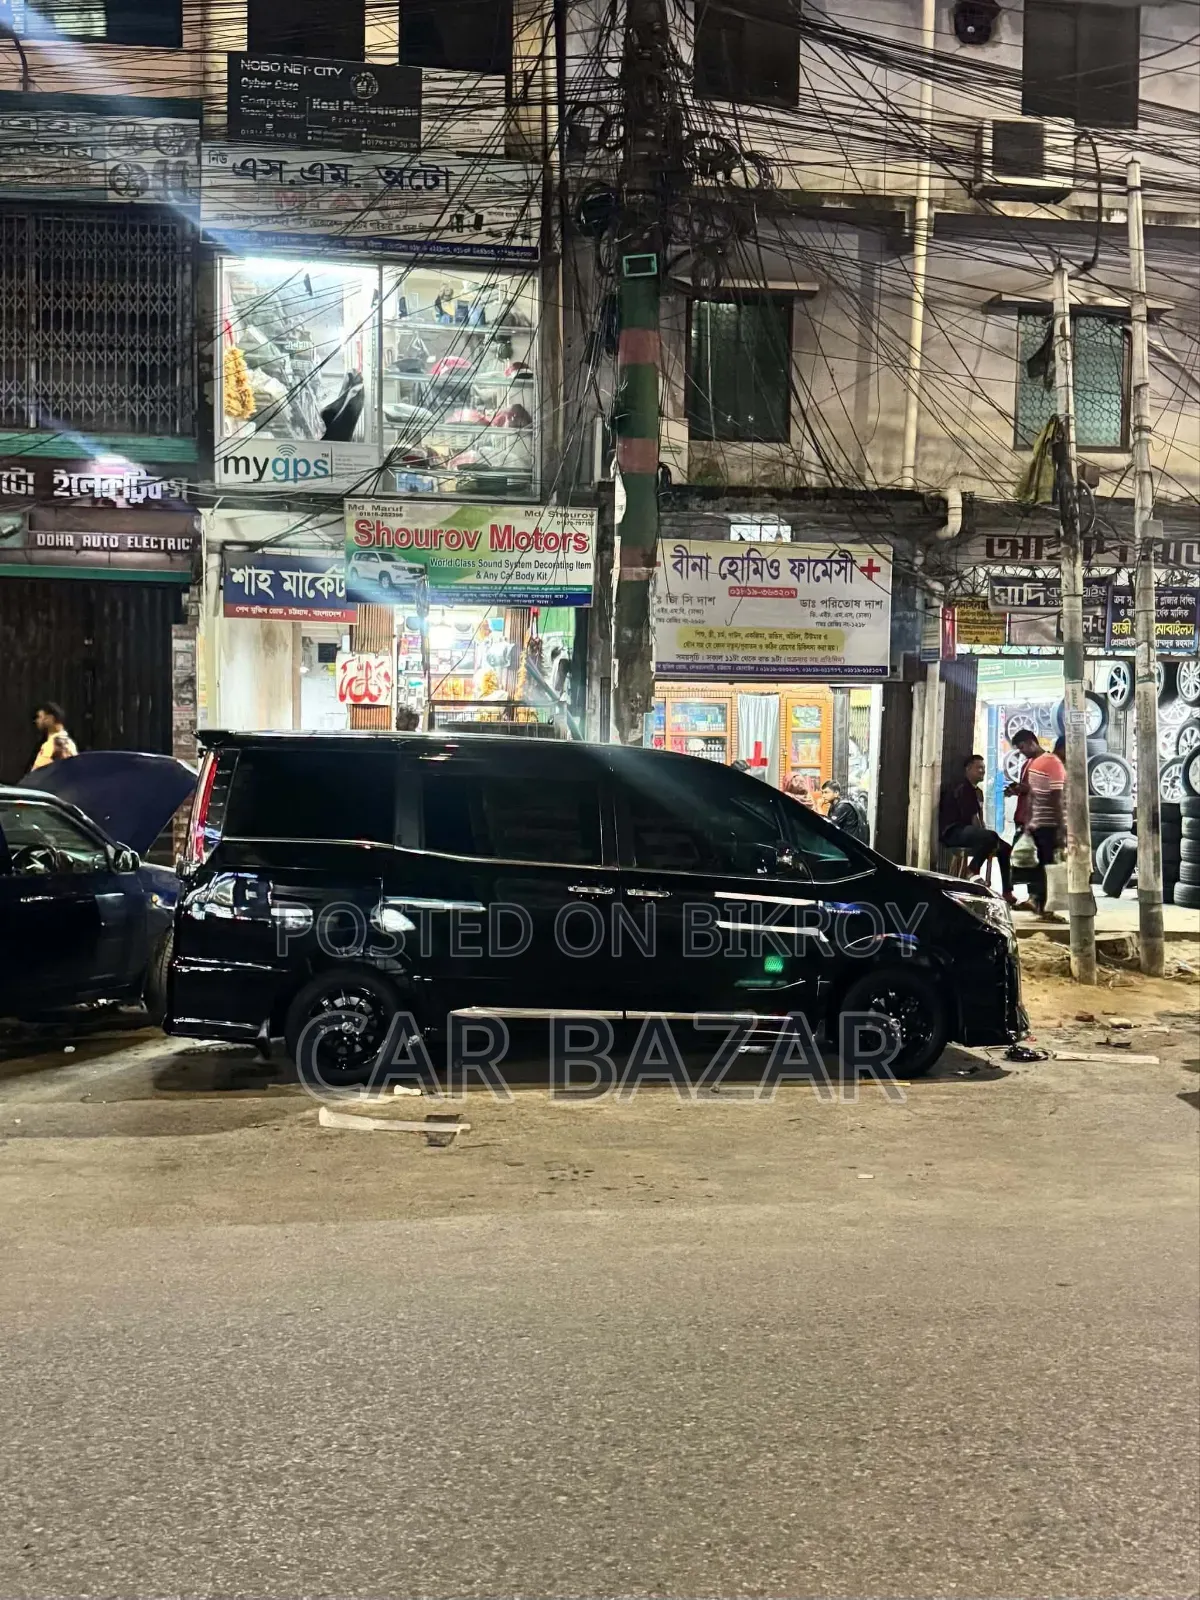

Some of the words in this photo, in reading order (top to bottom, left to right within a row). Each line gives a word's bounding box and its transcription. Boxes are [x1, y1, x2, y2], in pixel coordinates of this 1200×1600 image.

[371, 504, 404, 512] Maruf
[547, 510, 594, 520] Shourov
[36, 533, 74, 546] DOHA
[82, 535, 119, 548] AUTO
[353, 518, 482, 551] Shourov
[488, 523, 590, 554] Motors
[430, 558, 454, 568] World
[454, 558, 476, 569] Class
[478, 558, 503, 570] Sound
[504, 559, 532, 571] System
[533, 560, 574, 572] Decorating
[575, 561, 592, 571] Item
[670, 544, 712, 581] বীনা
[718, 547, 781, 584] হোমিও
[787, 548, 856, 584] ফার্মেসী
[230, 564, 275, 600] শাহ
[483, 571, 499, 582] Any
[500, 571, 513, 581] Car
[515, 572, 535, 583] Body
[536, 572, 548, 581] Kit
[696, 596, 716, 606] দাশ
[819, 597, 862, 610] পরিতোষ
[864, 599, 884, 610] দাশ
[1112, 618, 1132, 635] হাজী
